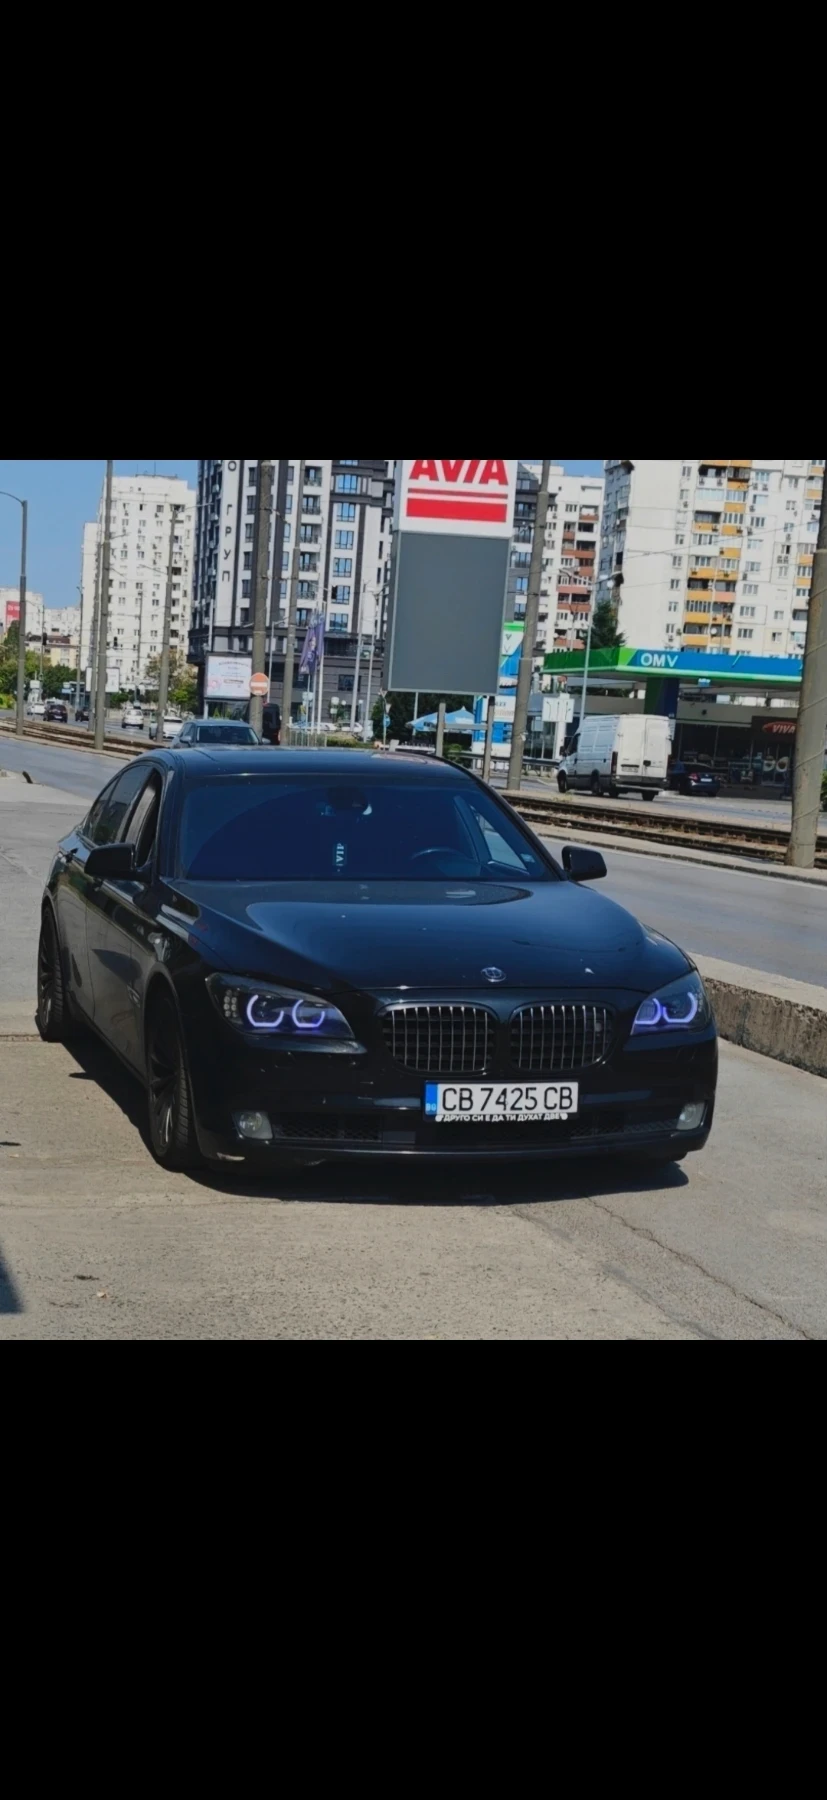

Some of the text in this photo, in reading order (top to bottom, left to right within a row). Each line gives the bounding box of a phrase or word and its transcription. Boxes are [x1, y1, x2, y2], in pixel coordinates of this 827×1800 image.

[409, 460, 508, 486] AVIA
[221, 504, 233, 582] ГРУП
[640, 653, 678, 668] OMV
[772, 724, 796, 734] VIVA
[336, 843, 345, 863] VIP
[442, 1087, 473, 1112] CB
[480, 1087, 538, 1111] 7425
[543, 1086, 573, 1110] CB
[443, 1114, 470, 1122] ДРУГО
[492, 1114, 504, 1122] ДА
[517, 1113, 542, 1121] ДУХАТ
[544, 1113, 560, 1121] ДВЕ
